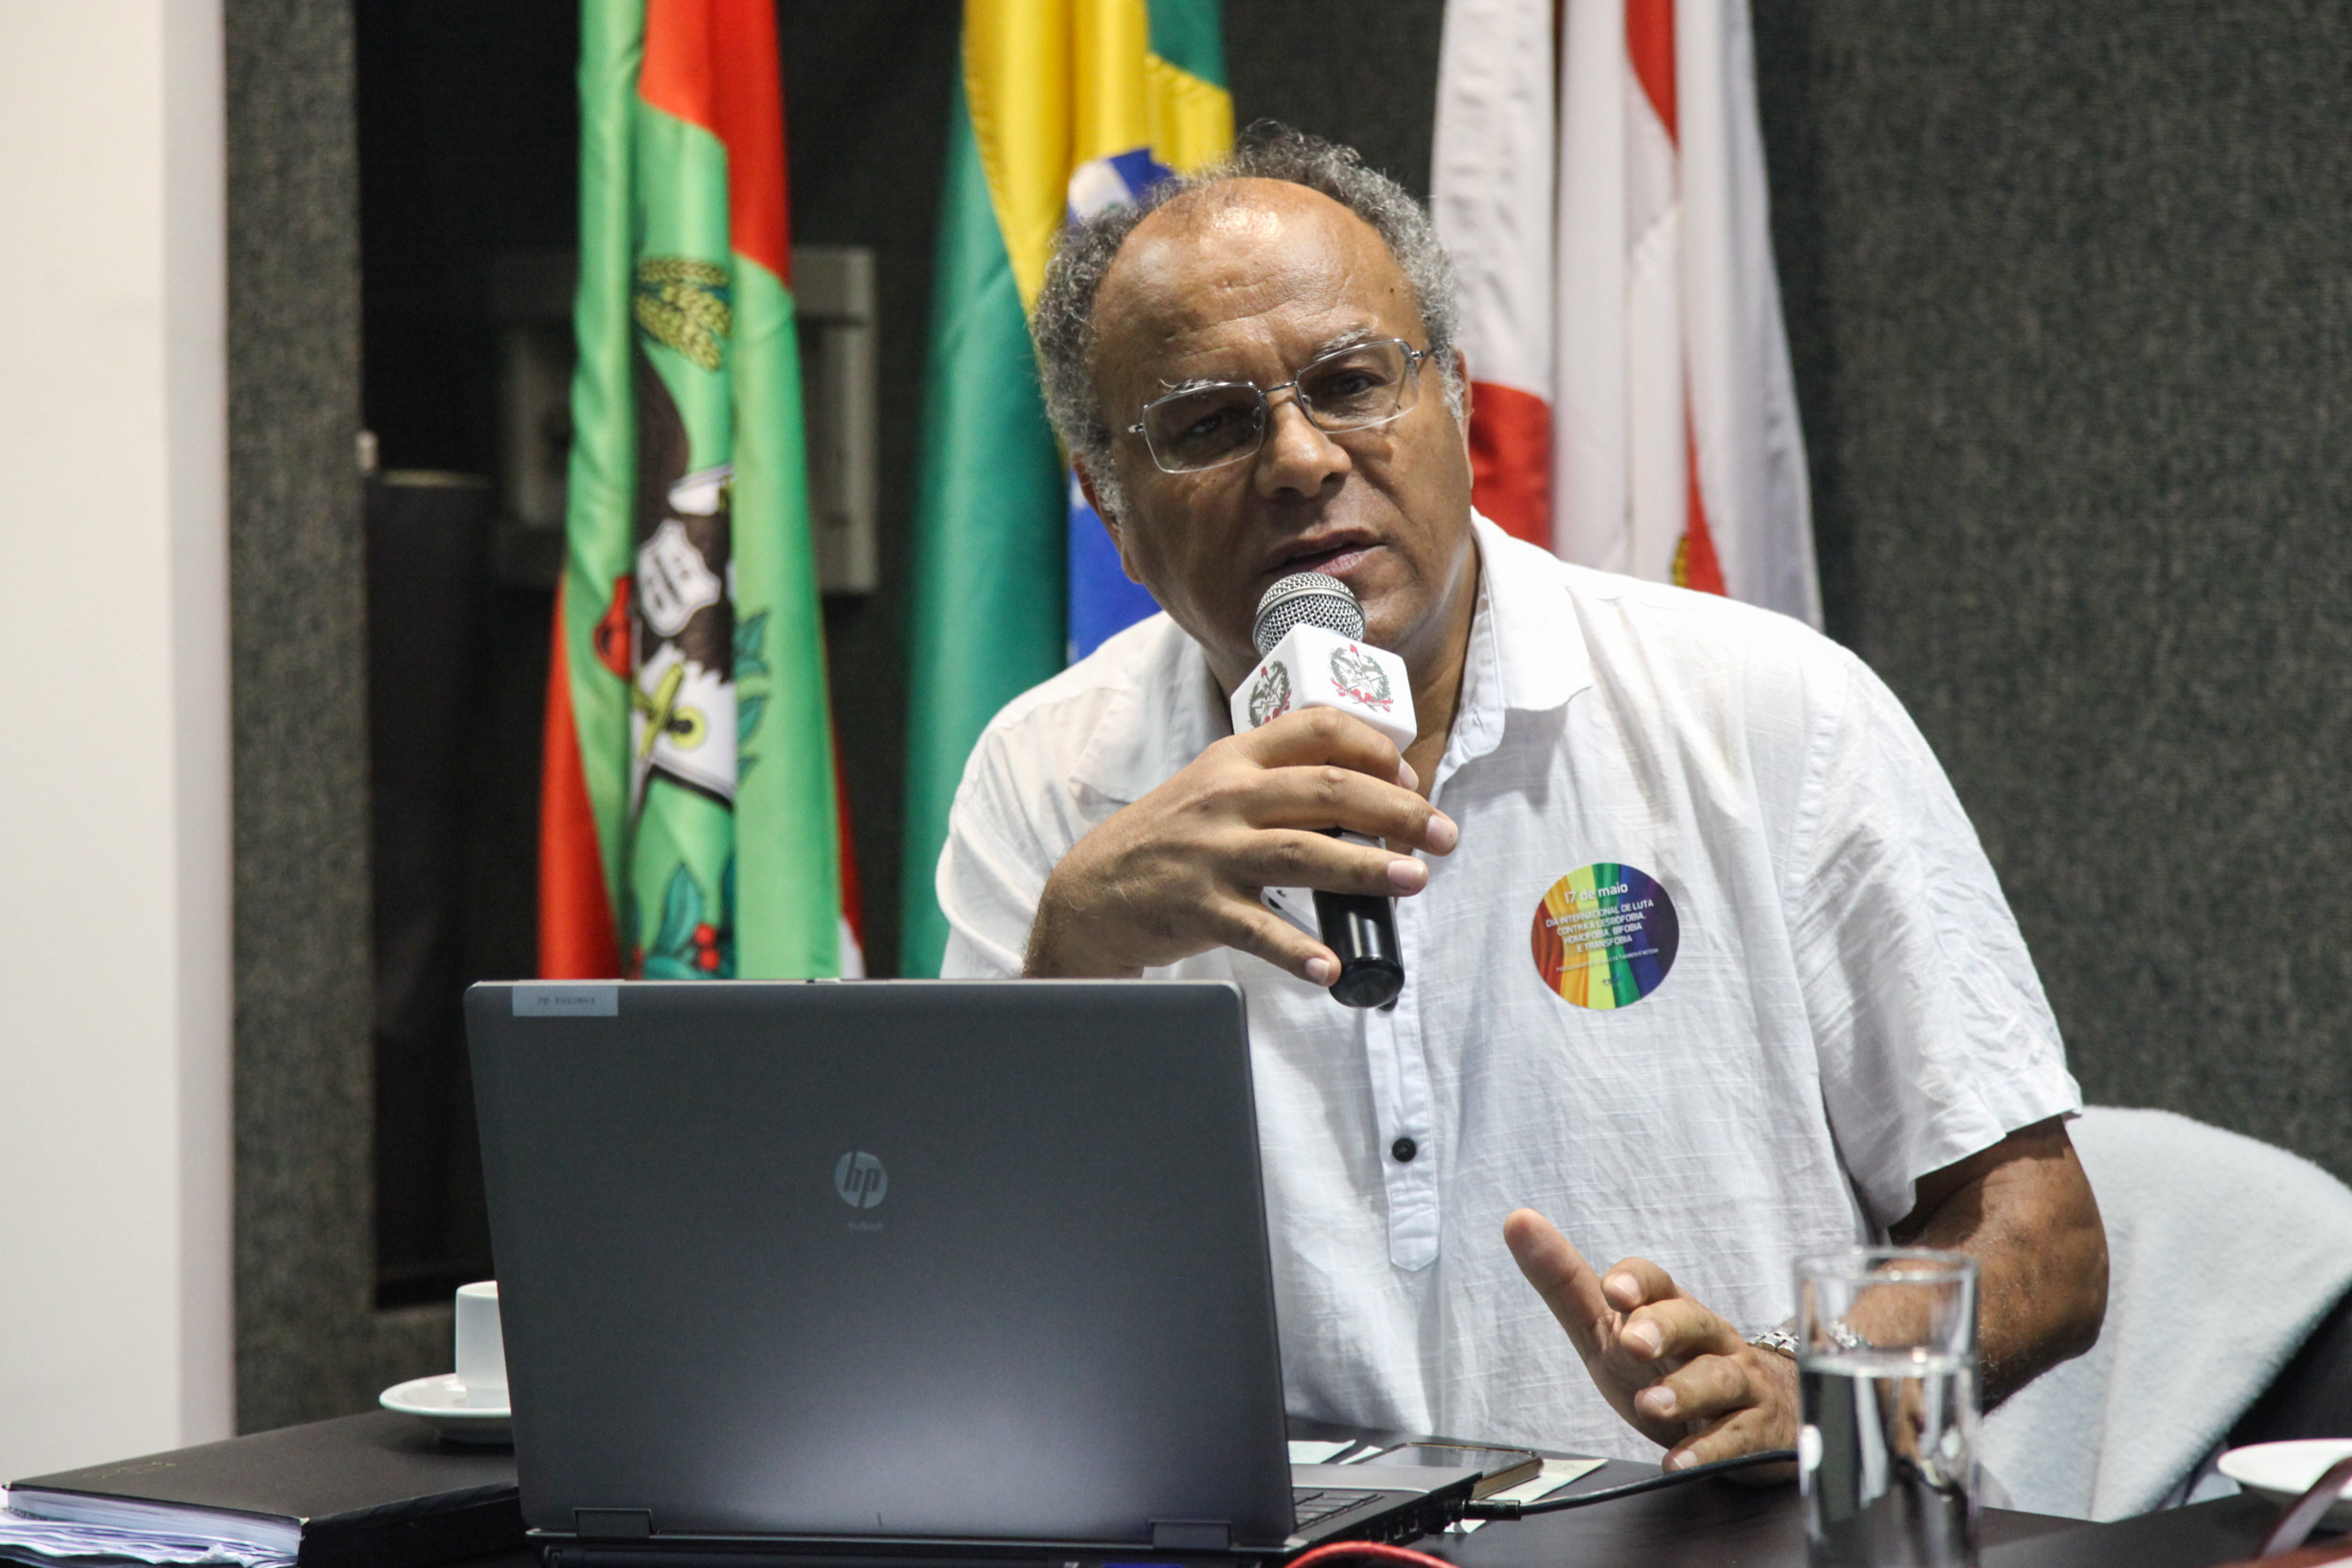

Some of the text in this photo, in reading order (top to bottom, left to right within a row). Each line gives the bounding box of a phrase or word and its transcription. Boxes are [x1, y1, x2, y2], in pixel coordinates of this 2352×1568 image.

[1564, 882, 1628, 904] 17 de maio
[1546, 899, 1654, 928] DIA INTERNACIONAL DE LUTA
[1557, 923, 1589, 937] CONTRA
[1612, 922, 1642, 935] BIFOBIA
[1577, 935, 1633, 953] E TRANSFOBIA
[840, 1150, 884, 1208] hp
